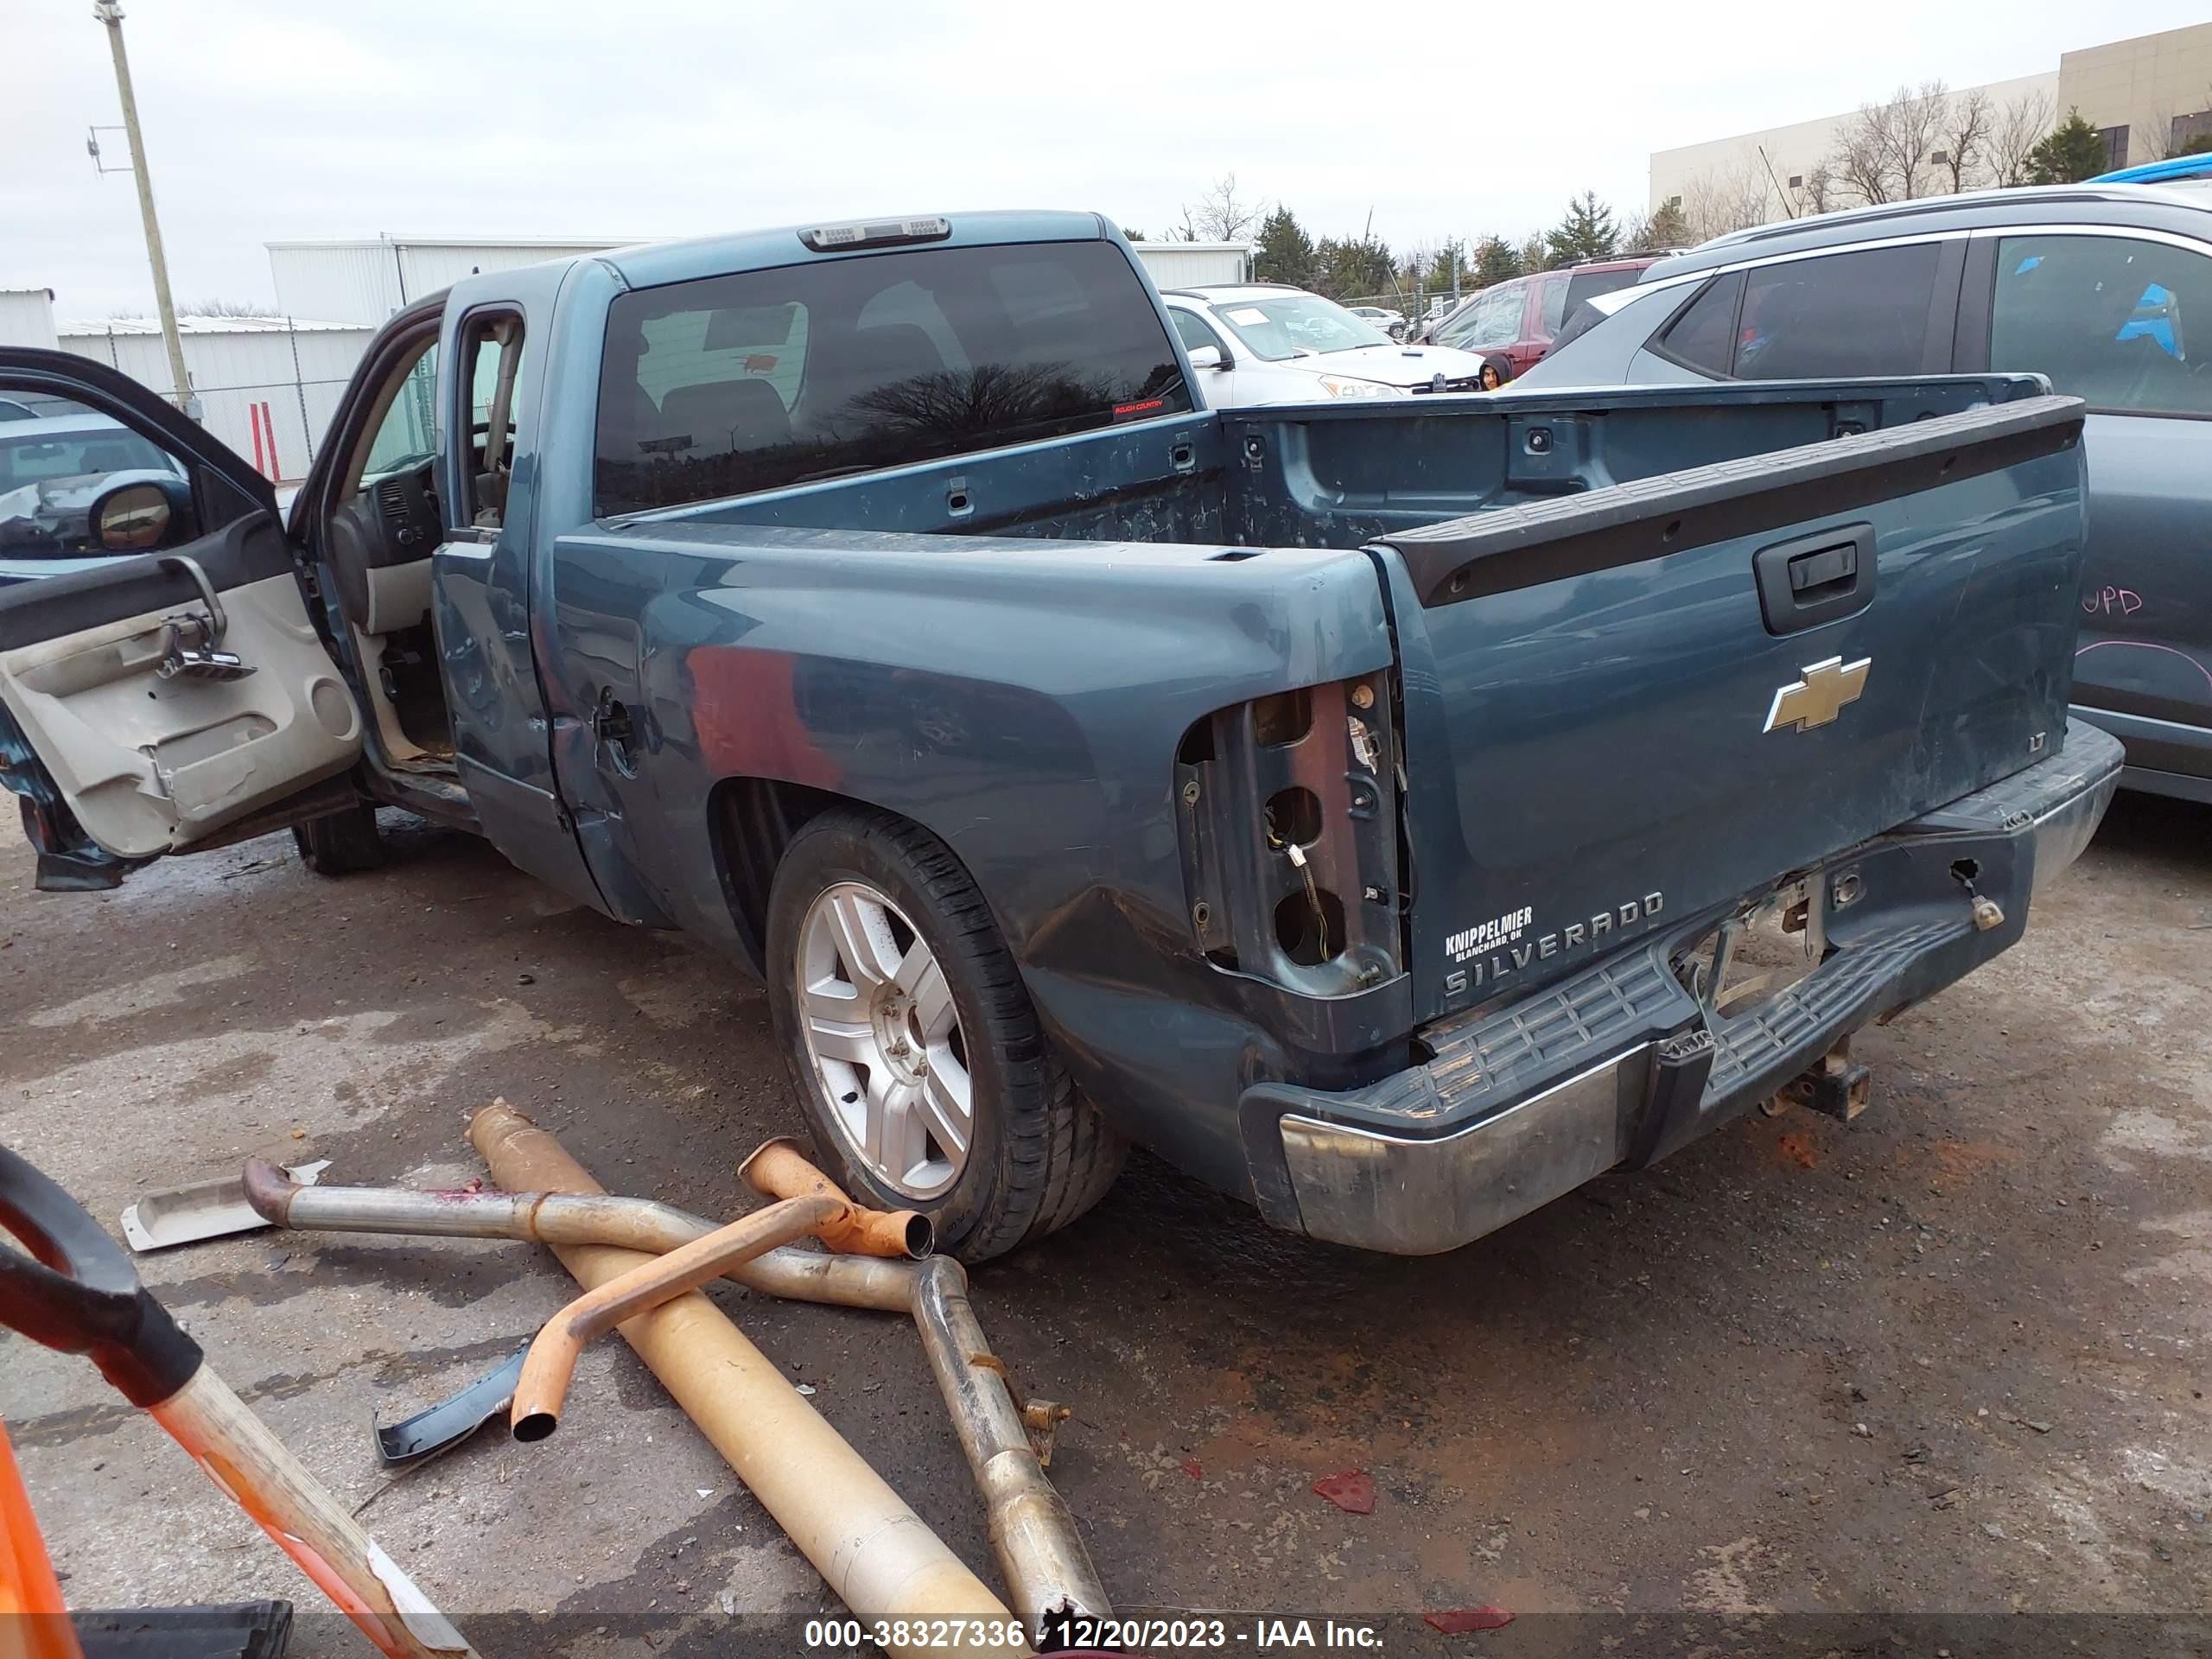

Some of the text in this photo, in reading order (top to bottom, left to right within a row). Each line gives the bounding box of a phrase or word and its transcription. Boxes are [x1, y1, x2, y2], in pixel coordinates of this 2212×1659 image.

[1433, 307, 1442, 316] 15
[1116, 400, 1162, 414] ROUGH COUNTRY
[2030, 732, 2047, 753] LT
[1445, 891, 1664, 998] SILVERADO
[1446, 906, 1533, 957] KNIPPELMIER
[1455, 929, 1522, 963] BLANCHARD, OK
